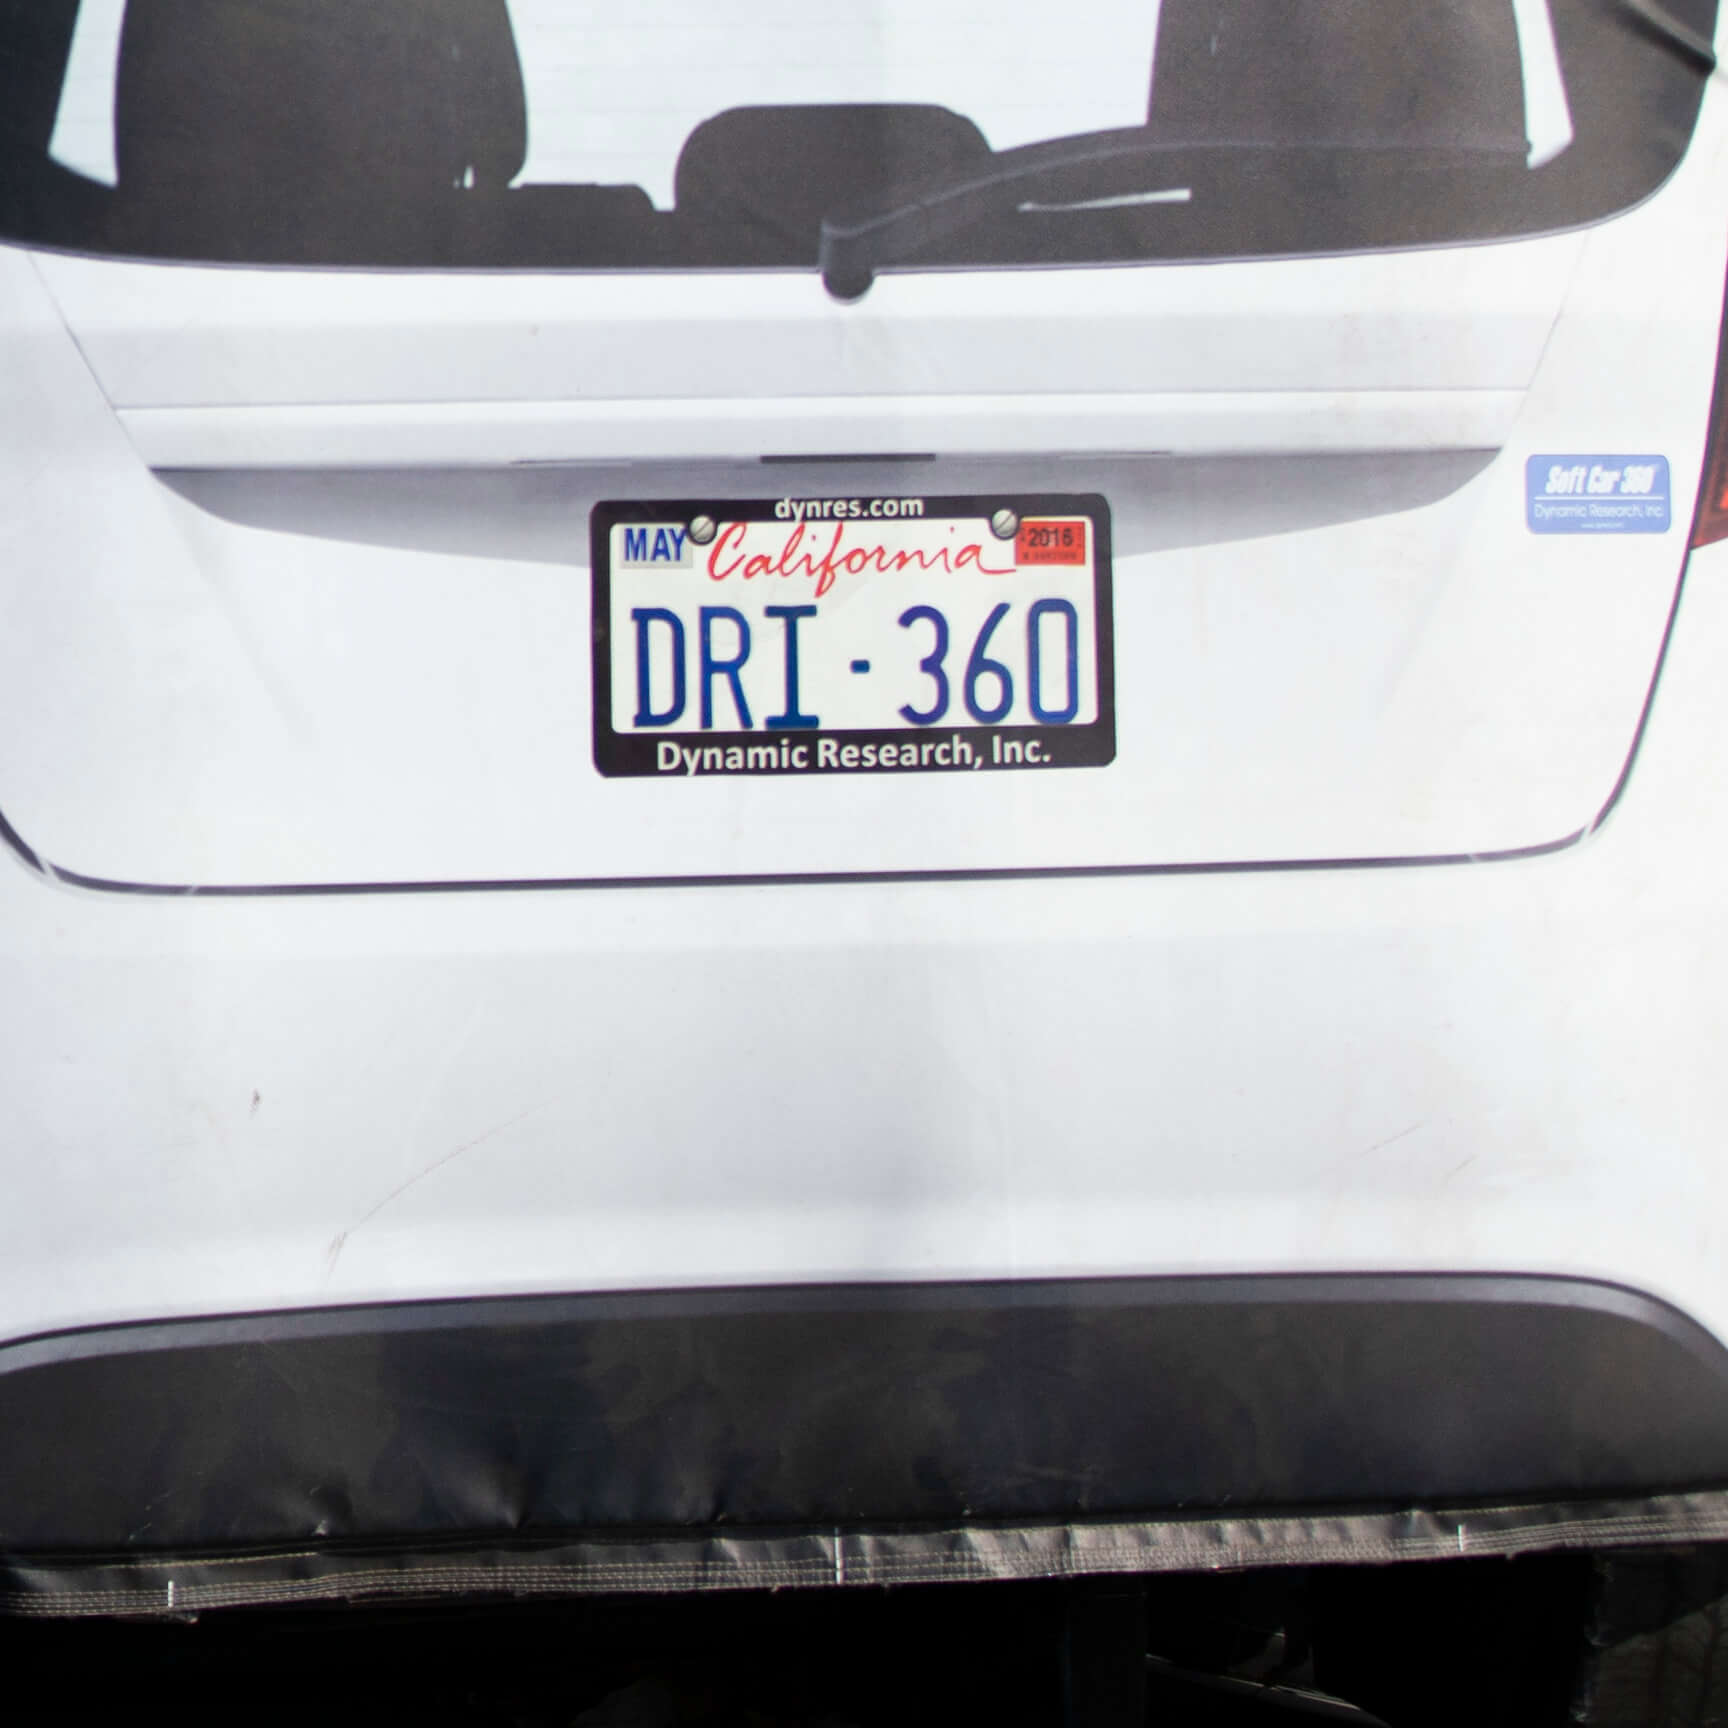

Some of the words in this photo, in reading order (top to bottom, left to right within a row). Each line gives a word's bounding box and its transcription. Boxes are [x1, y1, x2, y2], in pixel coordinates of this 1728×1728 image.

[1545, 464, 1587, 494] Soft
[775, 497, 924, 522] dynres.com
[1534, 503, 1587, 521] Dynamic
[624, 527, 687, 562] MAY
[1029, 527, 1074, 547] 2016
[707, 522, 1016, 598] California
[657, 739, 808, 776] Dynamic
[817, 734, 984, 769] Research,
[992, 735, 1052, 764] Inc.
